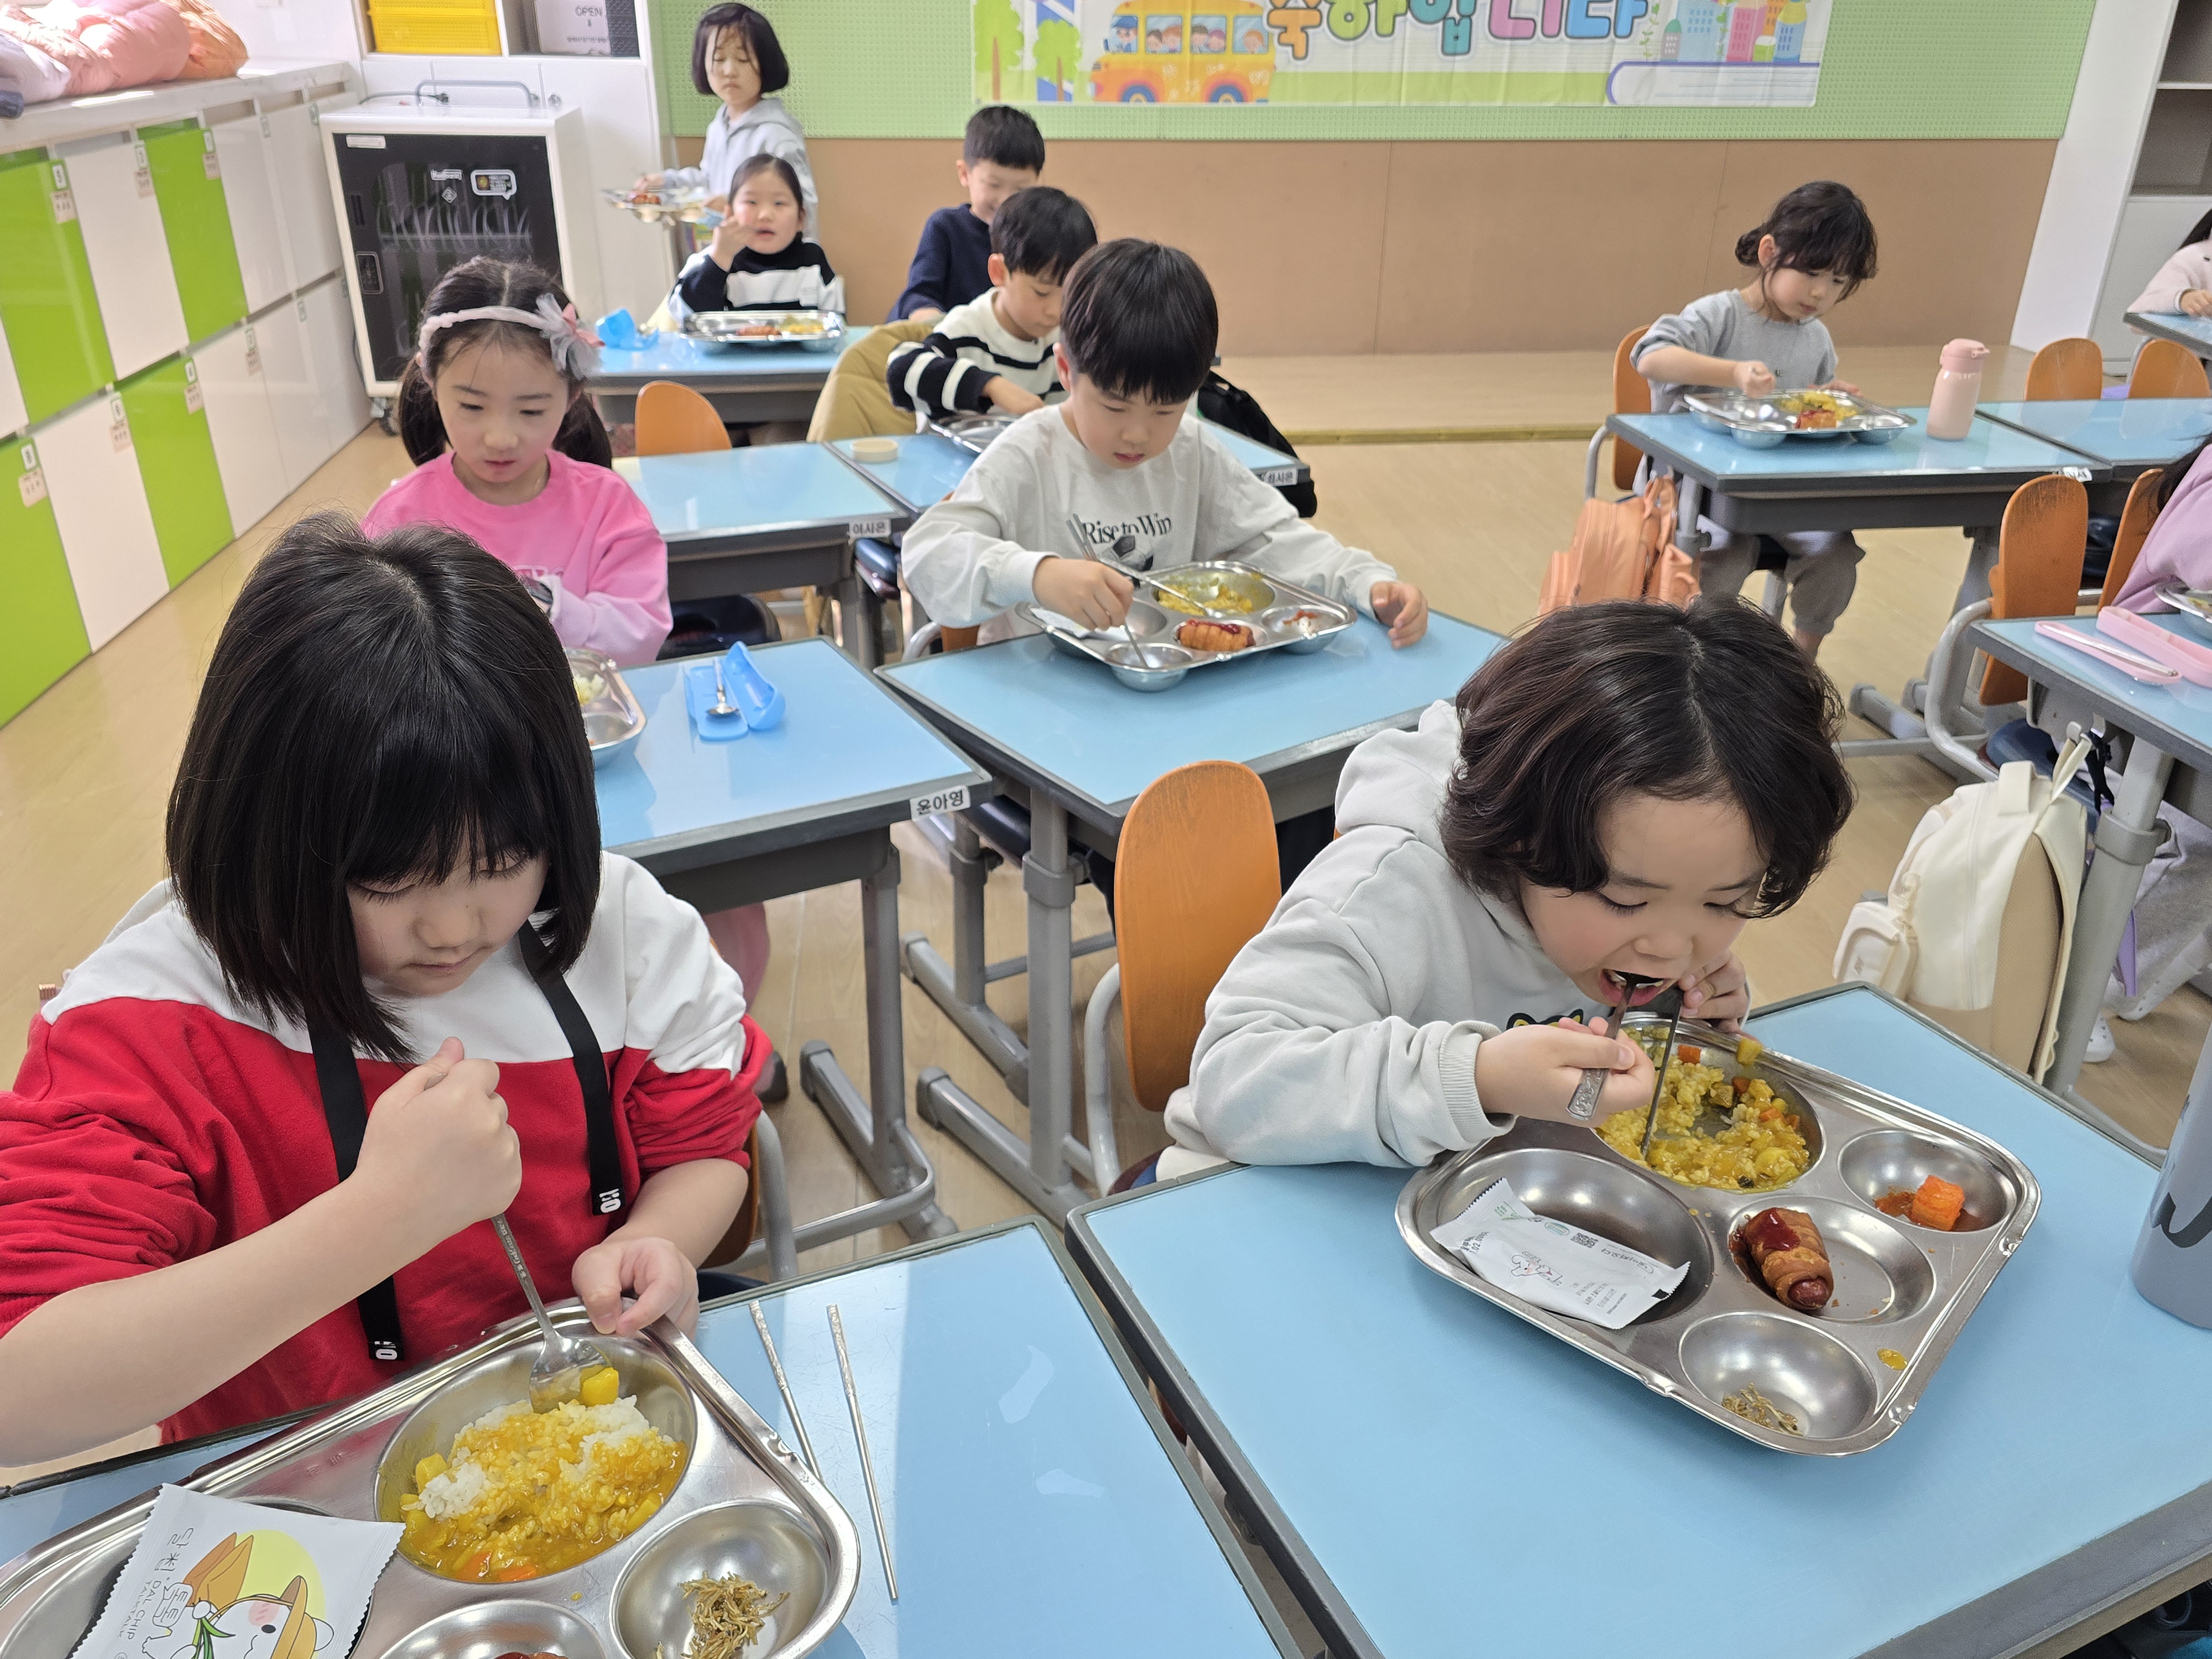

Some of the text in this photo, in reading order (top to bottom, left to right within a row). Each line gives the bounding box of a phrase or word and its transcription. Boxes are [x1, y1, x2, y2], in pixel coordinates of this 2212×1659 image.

[575, 7, 603, 17] OPEN
[1083, 520, 1119, 544] Rise
[1137, 513, 1172, 536] Win
[127, 1580, 162, 1640] DAL CHIP
